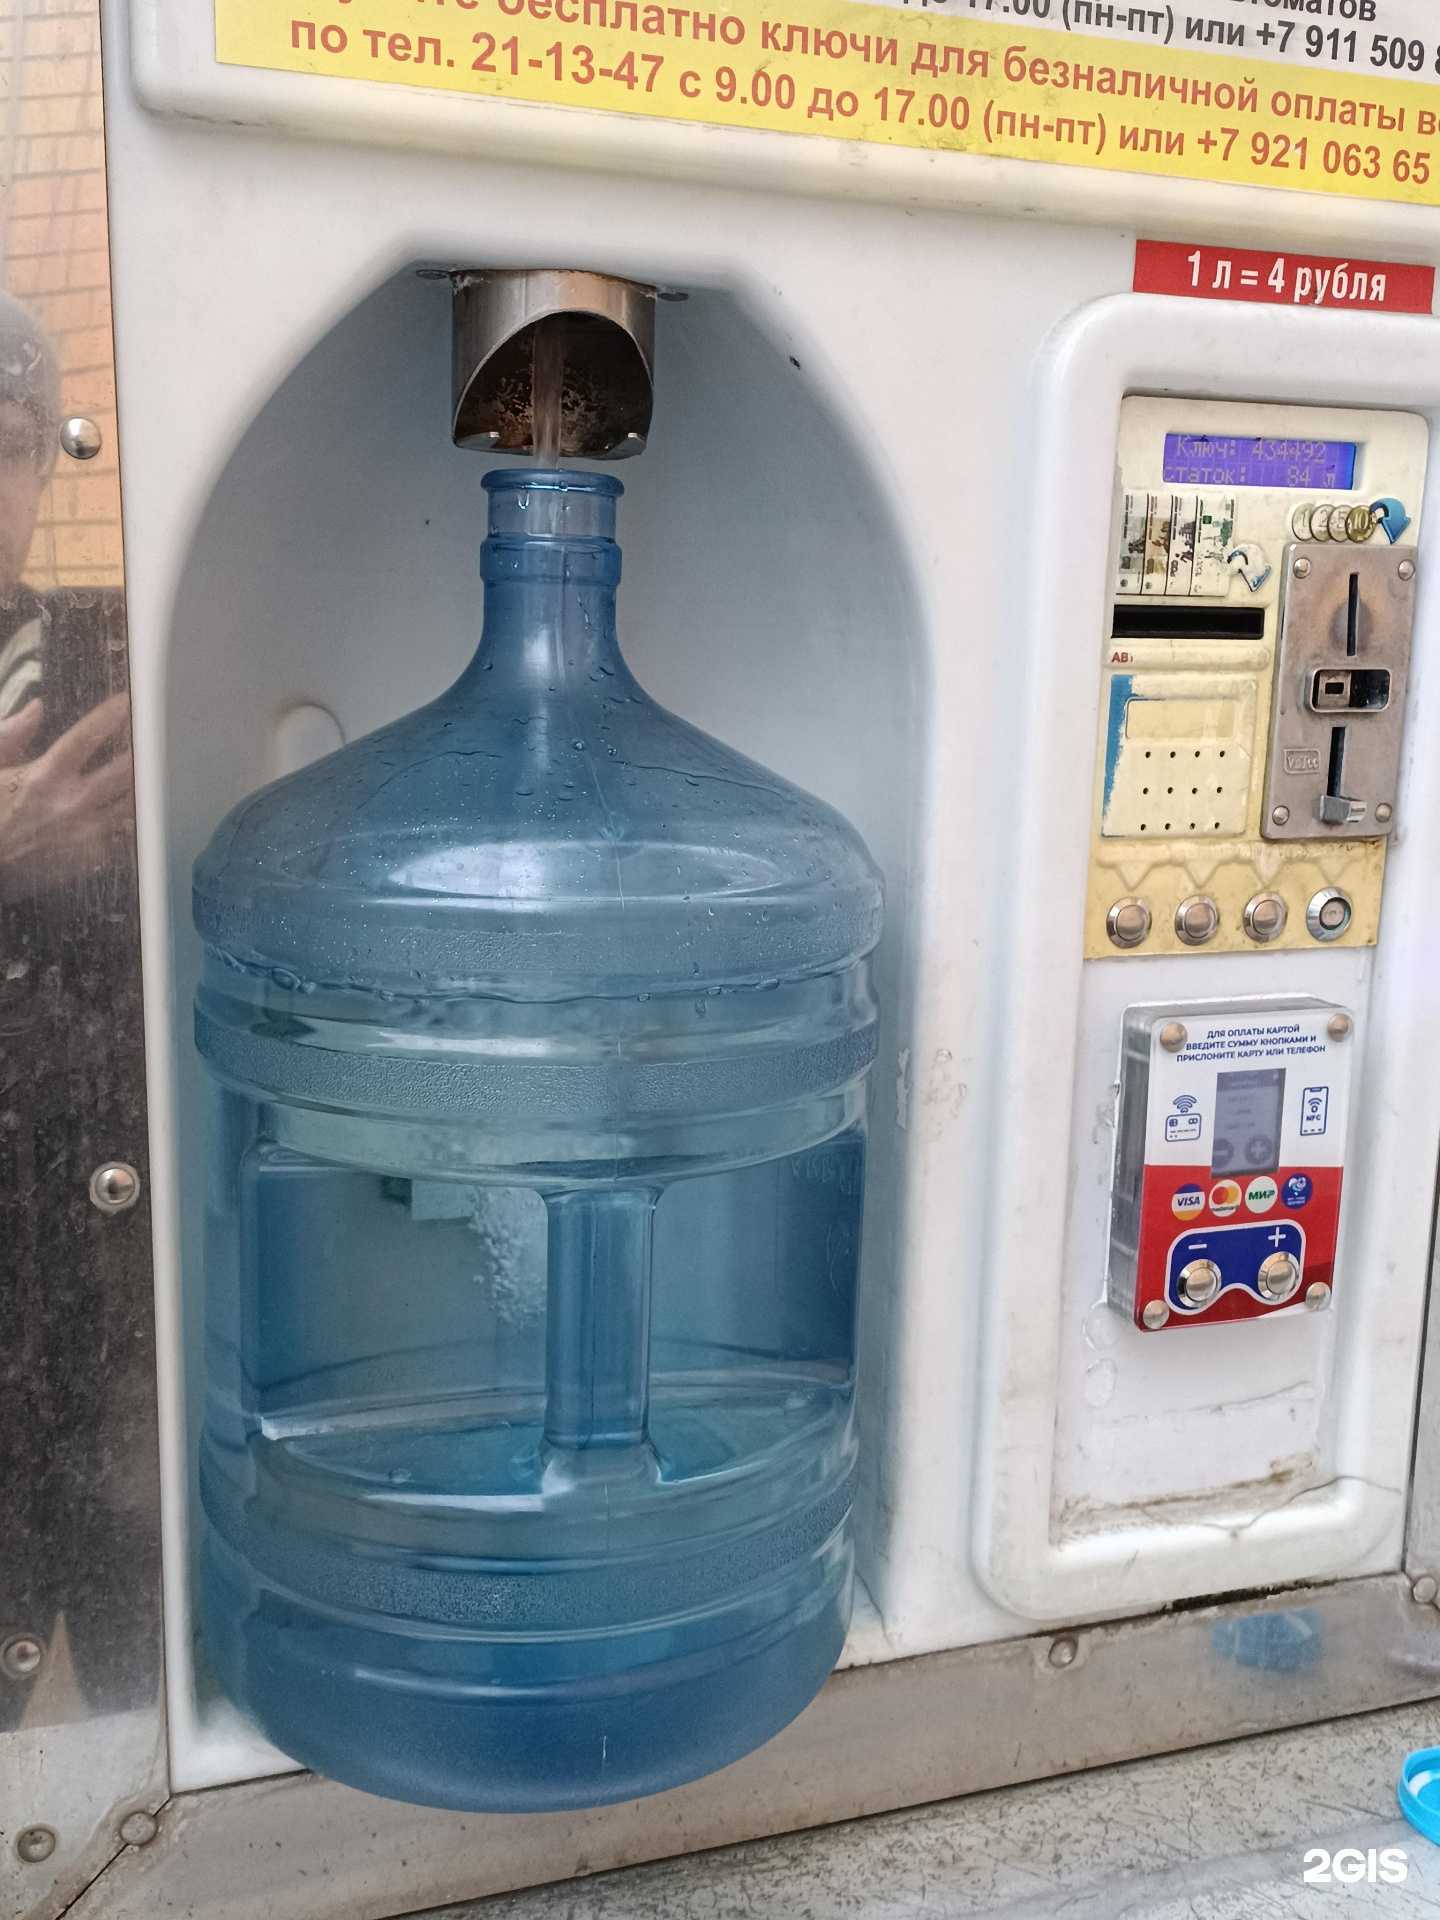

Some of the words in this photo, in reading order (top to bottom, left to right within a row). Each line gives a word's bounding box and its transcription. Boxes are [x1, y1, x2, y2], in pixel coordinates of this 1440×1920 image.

[1063, 0, 1174, 44] (пн-пт)
[1185, 17, 1245, 46] или
[1256, 20, 1295, 53] +7
[1305, 25, 1357, 62] 911
[1369, 34, 1425, 72] 509
[761, 20, 898, 65] ключи
[911, 42, 989, 78] для
[1004, 46, 1258, 112] безналичной
[1271, 90, 1405, 132] оплаты
[291, 20, 348, 53] по
[362, 29, 454, 68] тел.
[471, 31, 664, 92] 21-13-47
[679, 70, 701, 98] с
[715, 66, 795, 109] 9.00
[807, 87, 859, 120] до
[874, 87, 970, 130] 17.00
[984, 100, 1106, 155] (пн-пт)
[1119, 125, 1184, 156] или
[1197, 127, 1239, 161] +7
[1251, 131, 1308, 170] 921
[1323, 141, 1380, 179] 063
[1393, 150, 1431, 185] 65
[1188, 250, 1201, 286] 1
[1212, 260, 1231, 289] л
[1240, 269, 1259, 286] =
[1267, 258, 1285, 293] 4
[1294, 262, 1387, 304] рубля
[1177, 435, 1236, 459] Ключ:
[1353, 508, 1370, 530] 10
[1207, 1028, 1225, 1039] ДЛЯ
[1228, 1027, 1264, 1037] ОПЛАТЫ
[1266, 1024, 1300, 1034] КАРТОЙ
[1176, 1051, 1235, 1062] ПРИСЛОНИТЕ
[1237, 1050, 1263, 1058] КАРТУ
[1266, 1048, 1284, 1056] ИЛИ
[1286, 1045, 1326, 1055] ТЕЛЕФОН
[1186, 1041, 1225, 1050] ВВЕДИТЕ
[1227, 1039, 1258, 1048] СУММУ
[1260, 1036, 1308, 1046] КНОПКАМИ
[1177, 1196, 1201, 1206] VISA
[1248, 1190, 1276, 1201] МИР
